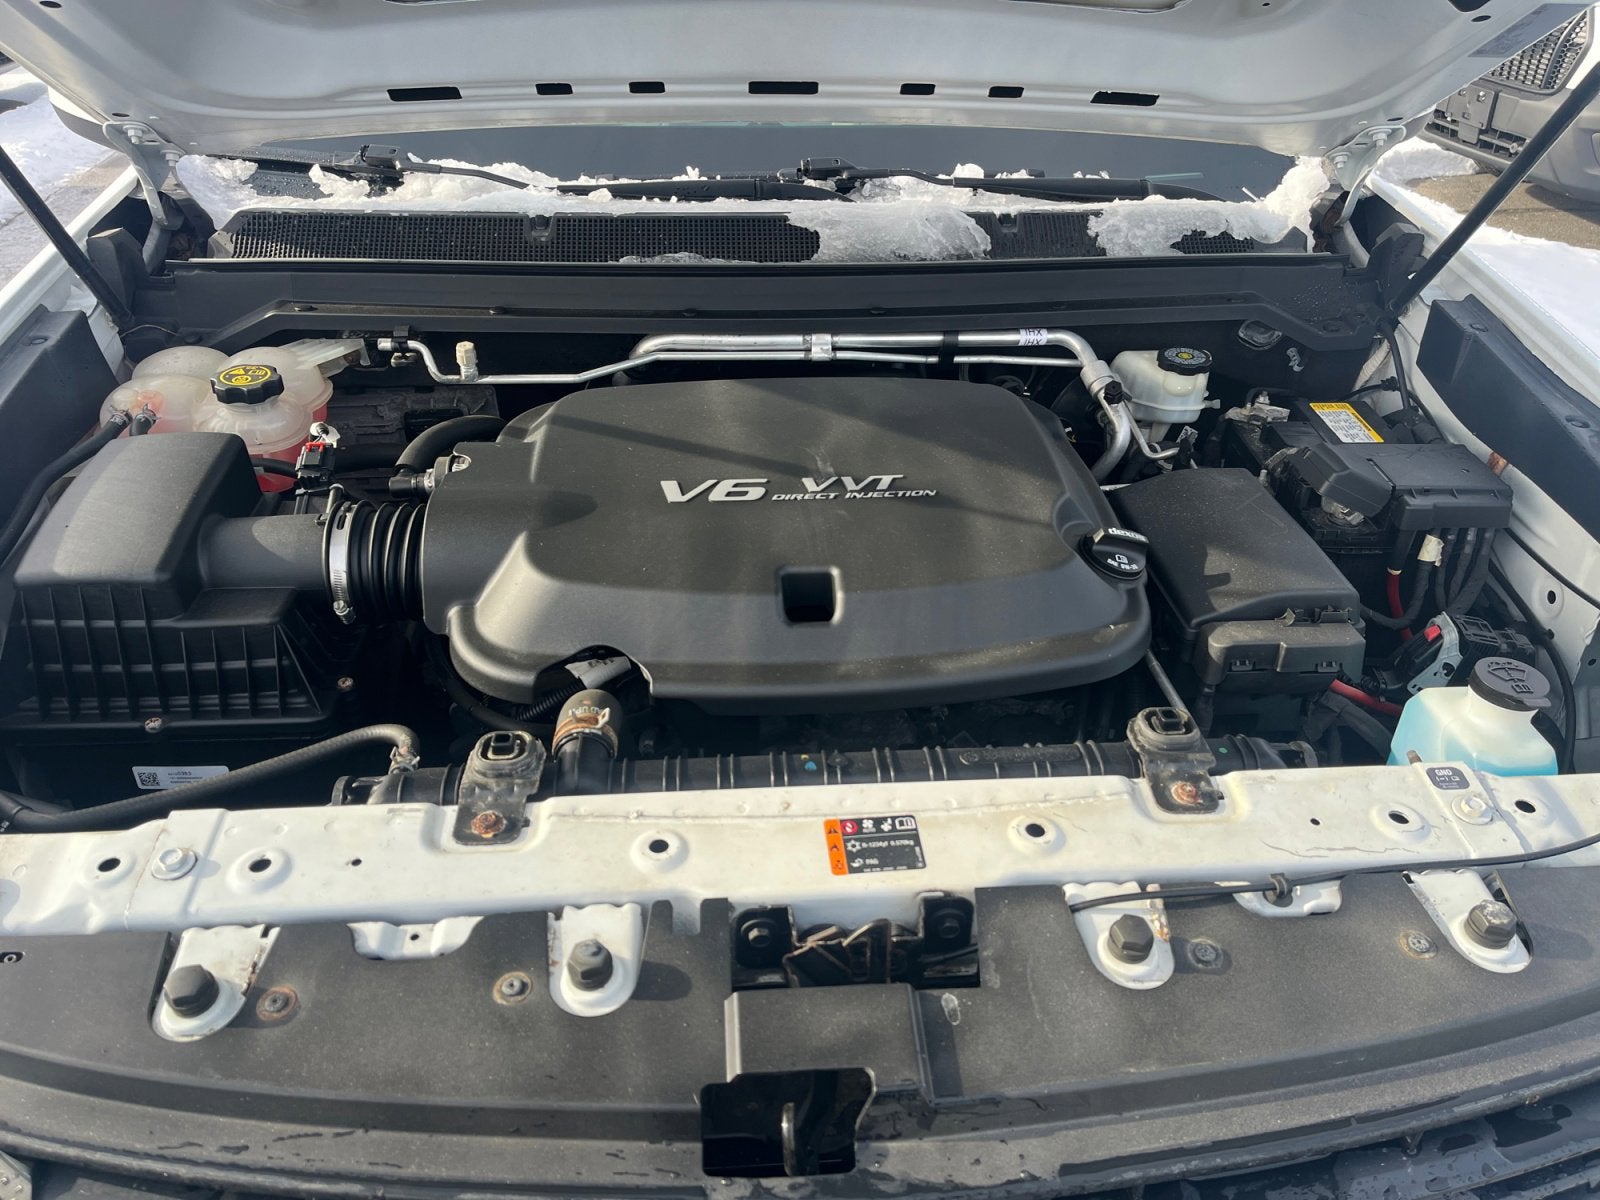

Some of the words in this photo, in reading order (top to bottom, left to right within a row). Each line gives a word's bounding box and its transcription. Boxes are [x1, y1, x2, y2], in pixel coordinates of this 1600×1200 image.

[660, 478, 768, 503] V6
[801, 474, 904, 492] VVT
[771, 492, 839, 501] DIRECT
[845, 489, 937, 499] INJECTION
[1435, 768, 1453, 776] GND
